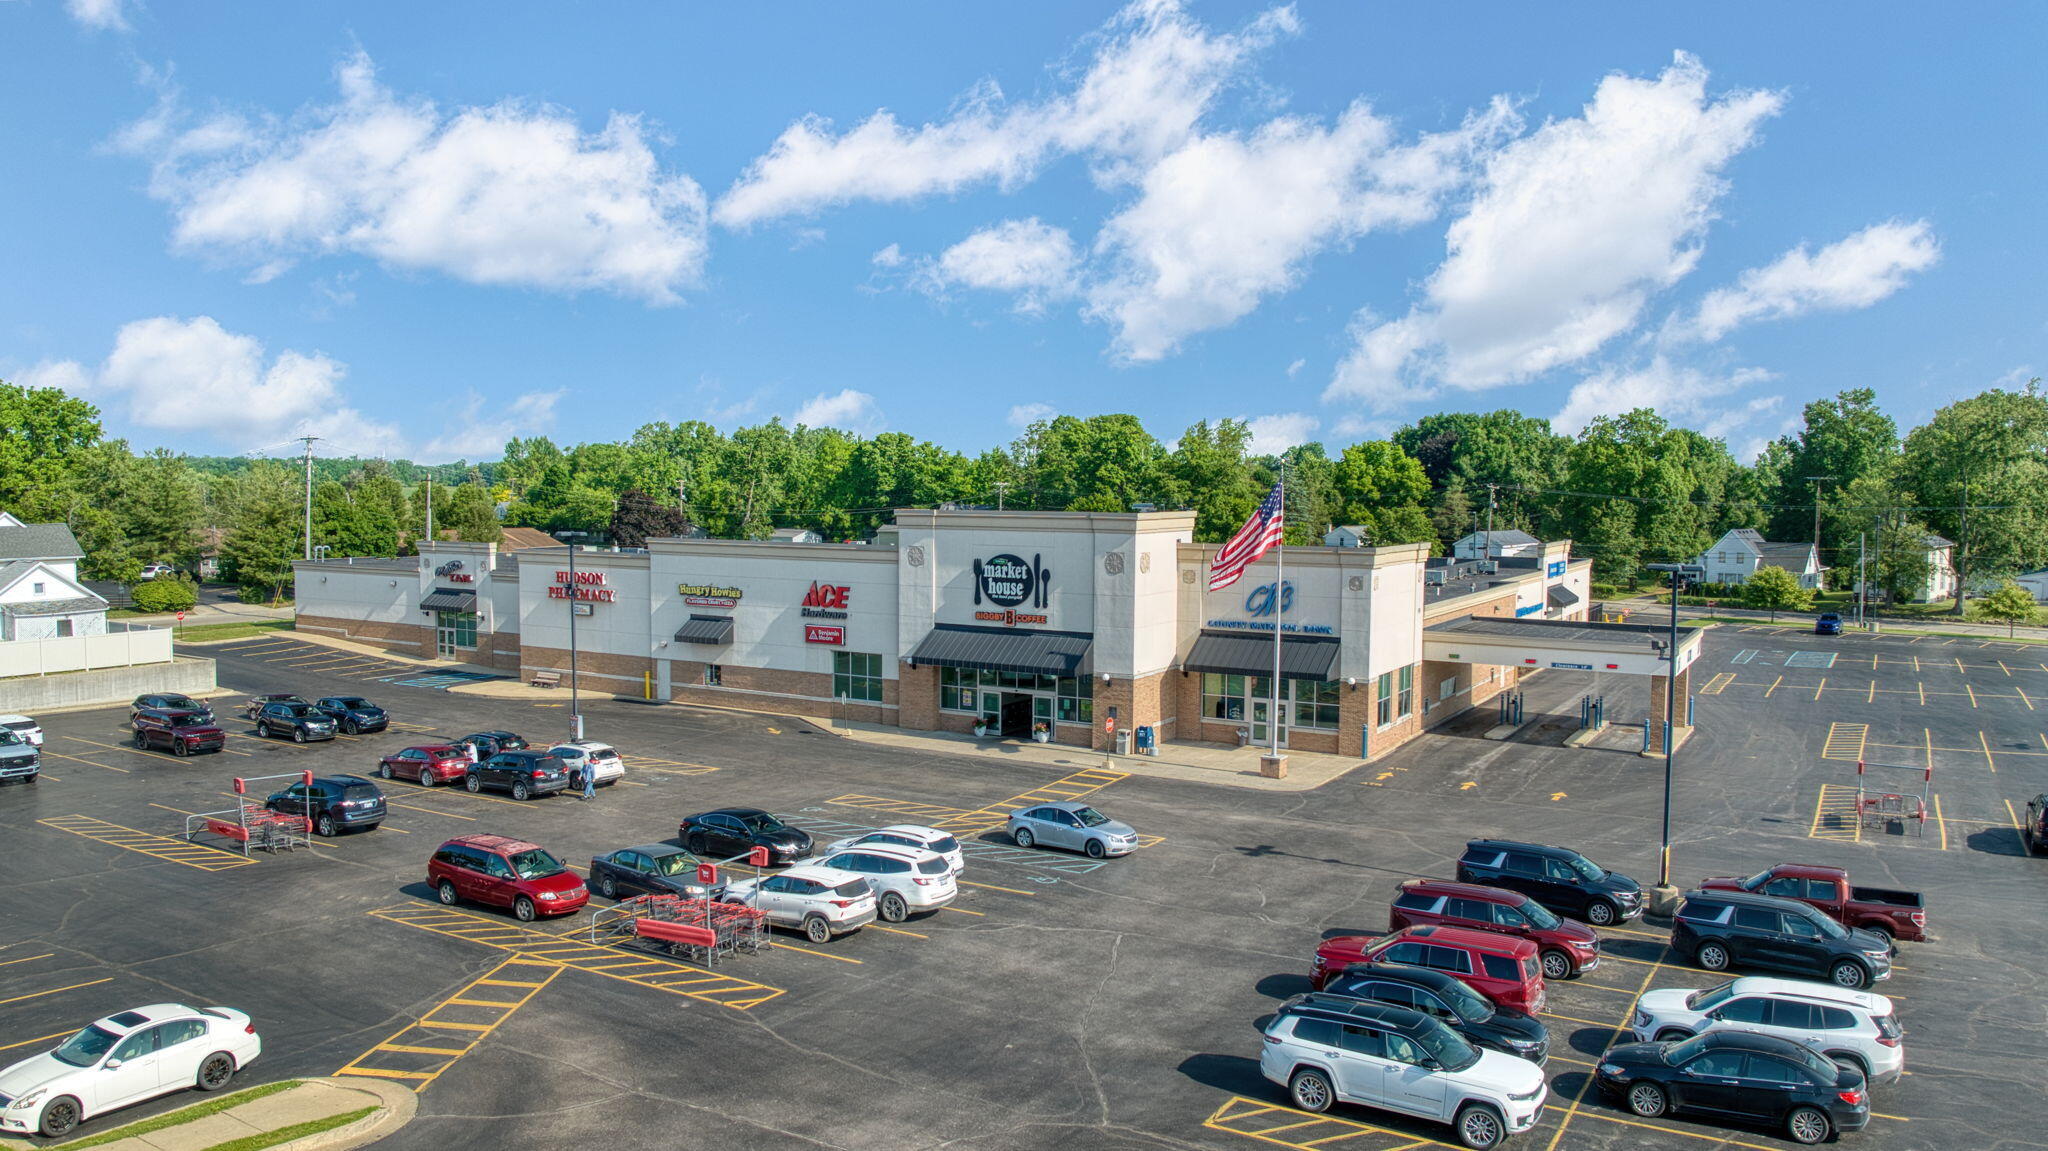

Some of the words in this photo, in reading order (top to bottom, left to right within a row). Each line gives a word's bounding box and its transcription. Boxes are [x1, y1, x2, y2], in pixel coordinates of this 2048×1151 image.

[983, 562, 1027, 579] market
[556, 571, 605, 585] HUDSON
[679, 584, 710, 597] Hungry
[987, 577, 1024, 595] house
[801, 579, 850, 609] ACE
[801, 607, 848, 619] Hardware
[975, 611, 1005, 621] BIGGBY
[1015, 614, 1047, 624] COFFEE
[818, 630, 840, 638] Benjamin
